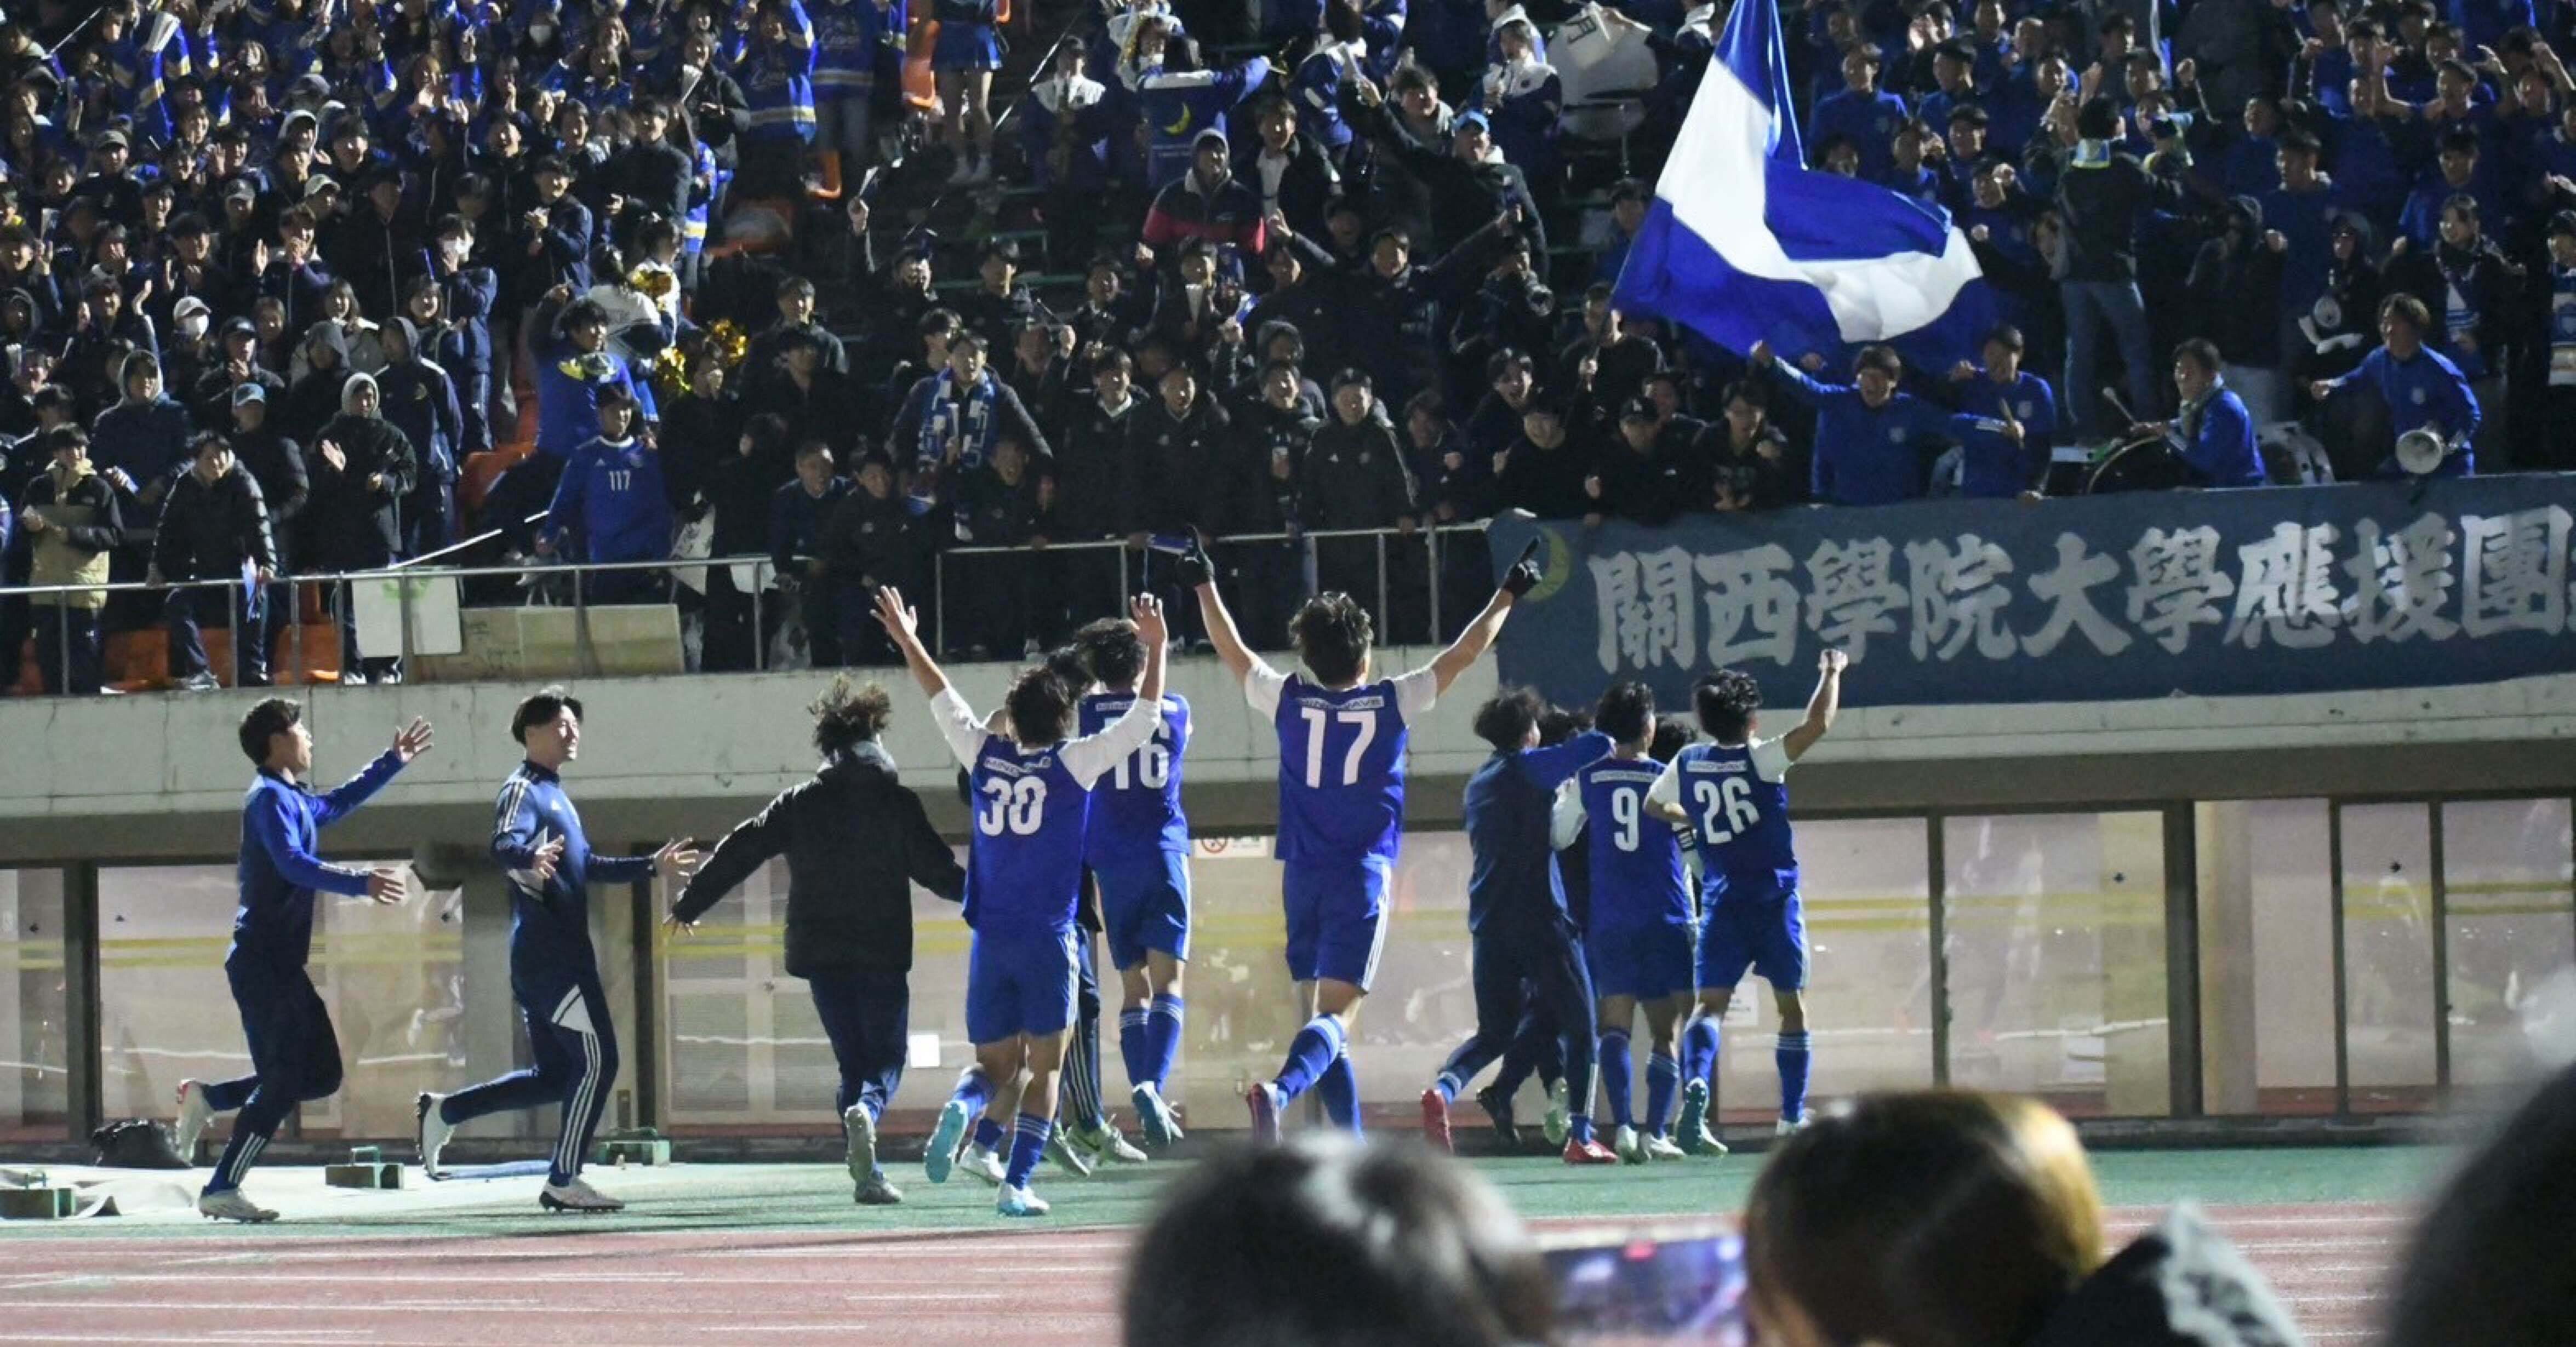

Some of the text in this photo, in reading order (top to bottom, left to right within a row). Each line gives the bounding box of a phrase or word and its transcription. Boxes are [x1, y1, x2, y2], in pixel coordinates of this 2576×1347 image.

[609, 469, 630, 491] 117
[1587, 503, 2576, 674] 關西學院大學應援團
[1105, 717, 1170, 789] 16
[1301, 707, 1375, 789] 17
[979, 776, 1047, 836] 30
[1612, 787, 1639, 851] 9
[1693, 777, 1760, 844] 26
